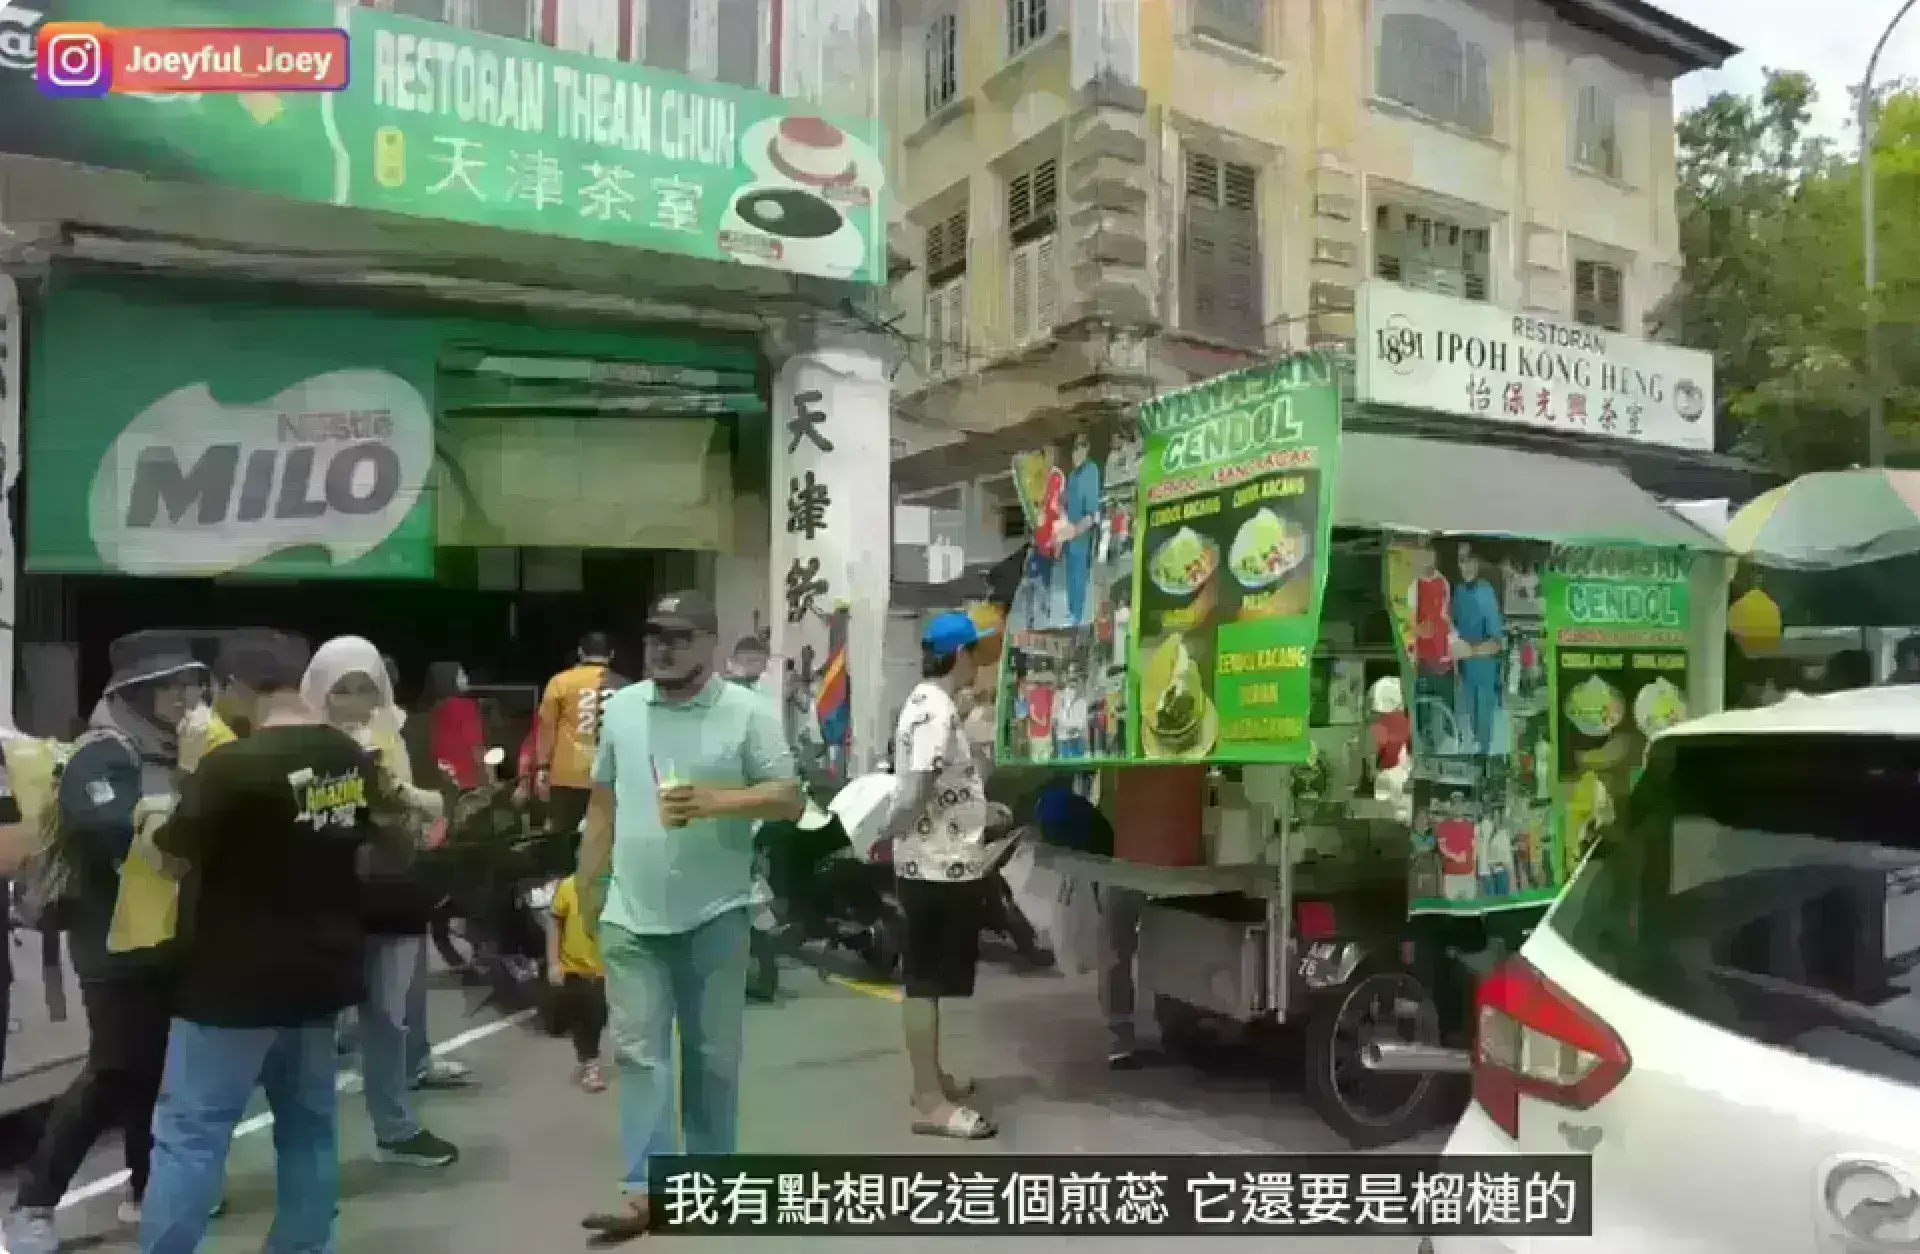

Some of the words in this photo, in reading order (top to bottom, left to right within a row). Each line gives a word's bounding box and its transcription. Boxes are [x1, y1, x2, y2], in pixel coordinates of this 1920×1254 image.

[374, 29, 544, 133] RESTORAN
[552, 65, 653, 155] THEAN
[424, 135, 703, 235] 天津茶室
[1376, 327, 1425, 366] 1891
[1435, 329, 1508, 373] IPOH
[1517, 345, 1592, 389] KONG
[1601, 360, 1663, 402] HENG
[1512, 315, 1607, 355] RESTORAN
[1162, 395, 1304, 473] CENDOL
[126, 442, 402, 527] MILO
[1565, 583, 1679, 627] CENDOL
